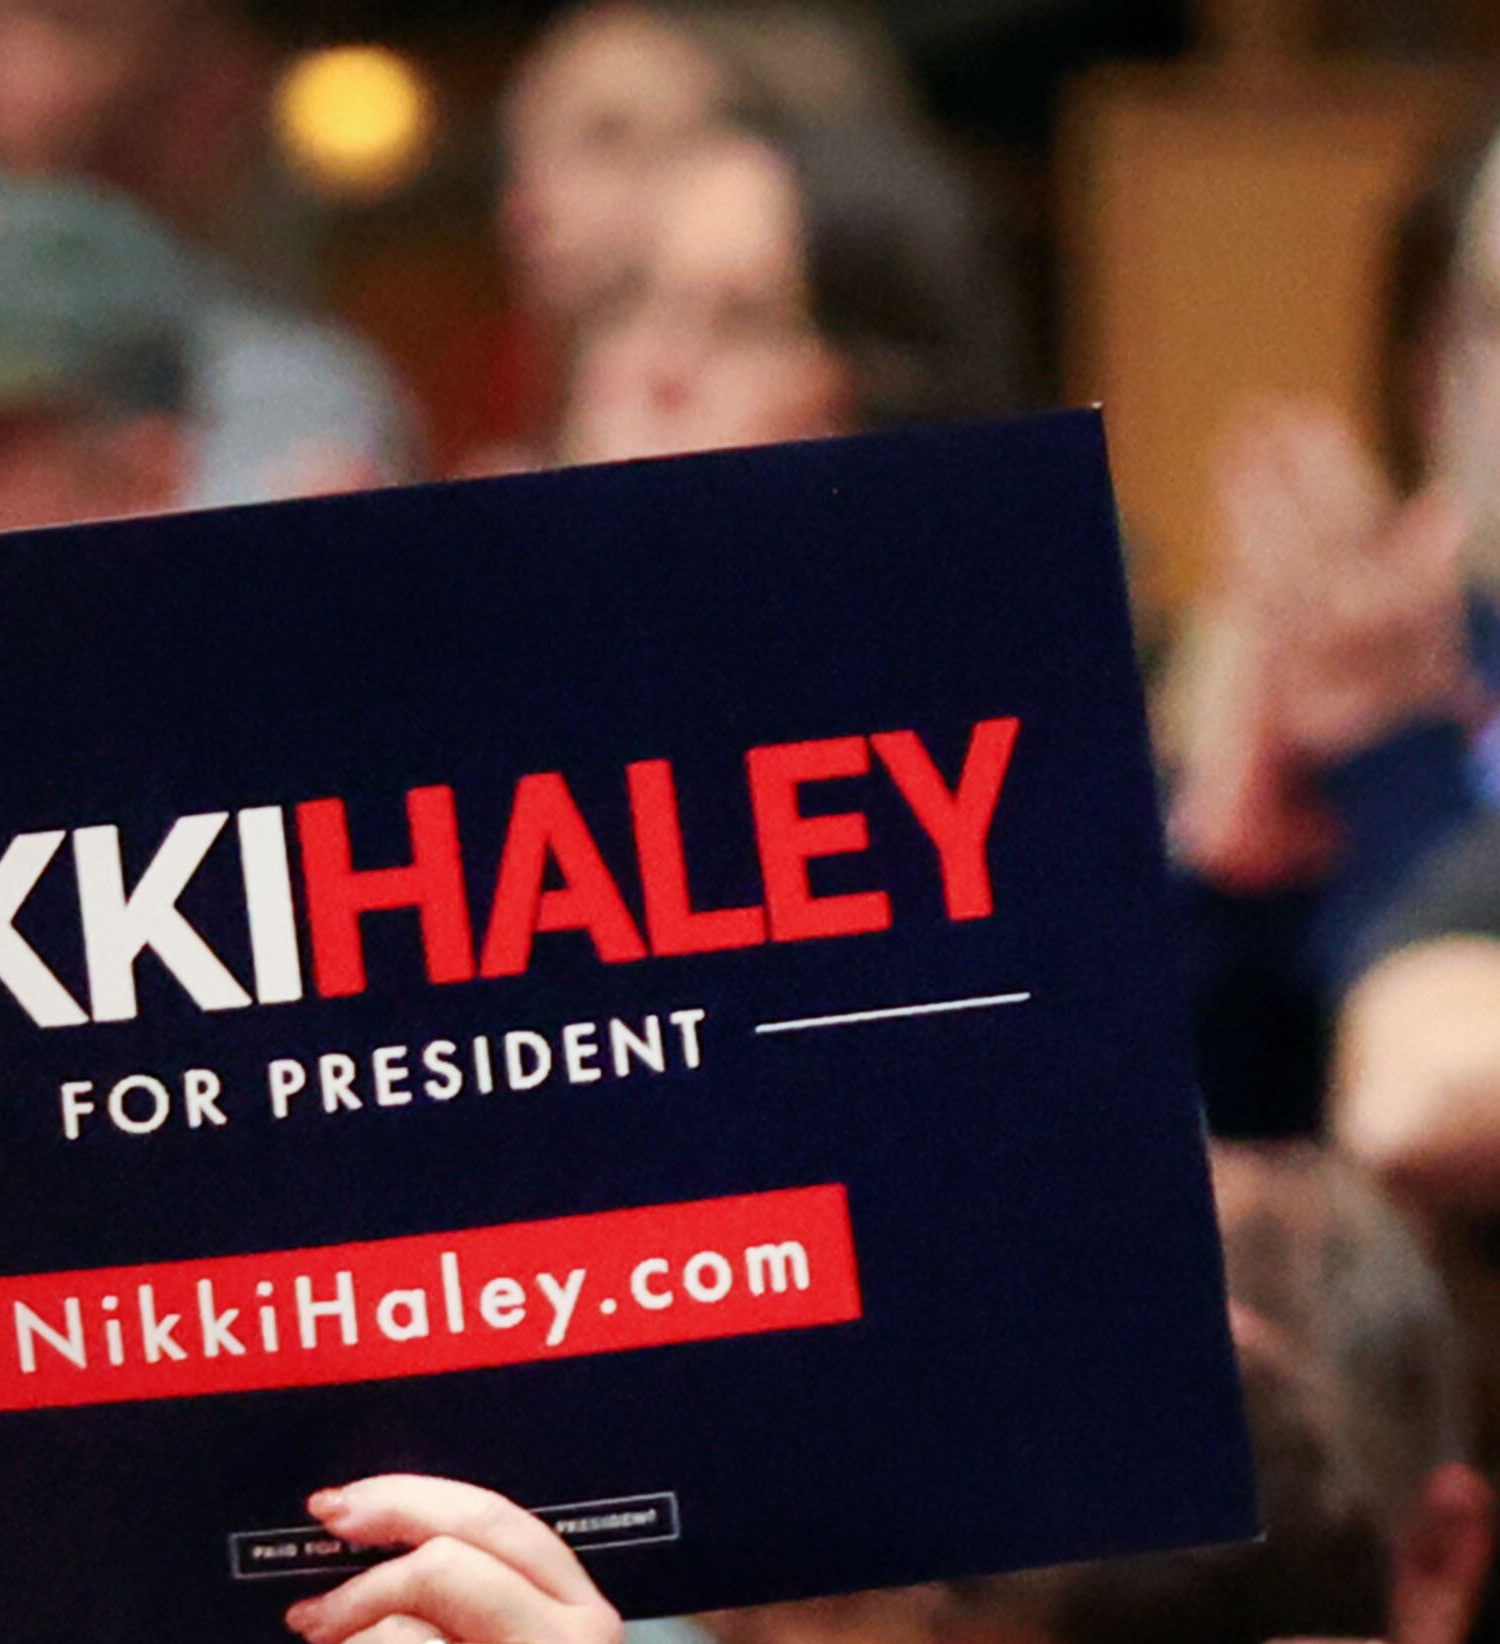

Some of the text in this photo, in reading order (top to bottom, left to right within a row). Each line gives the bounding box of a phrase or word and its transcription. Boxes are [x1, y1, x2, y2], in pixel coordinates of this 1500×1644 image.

[59, 1008, 706, 1141] FOR PRESIDENT
[11, 1238, 812, 1374] NikkiHaley.com
